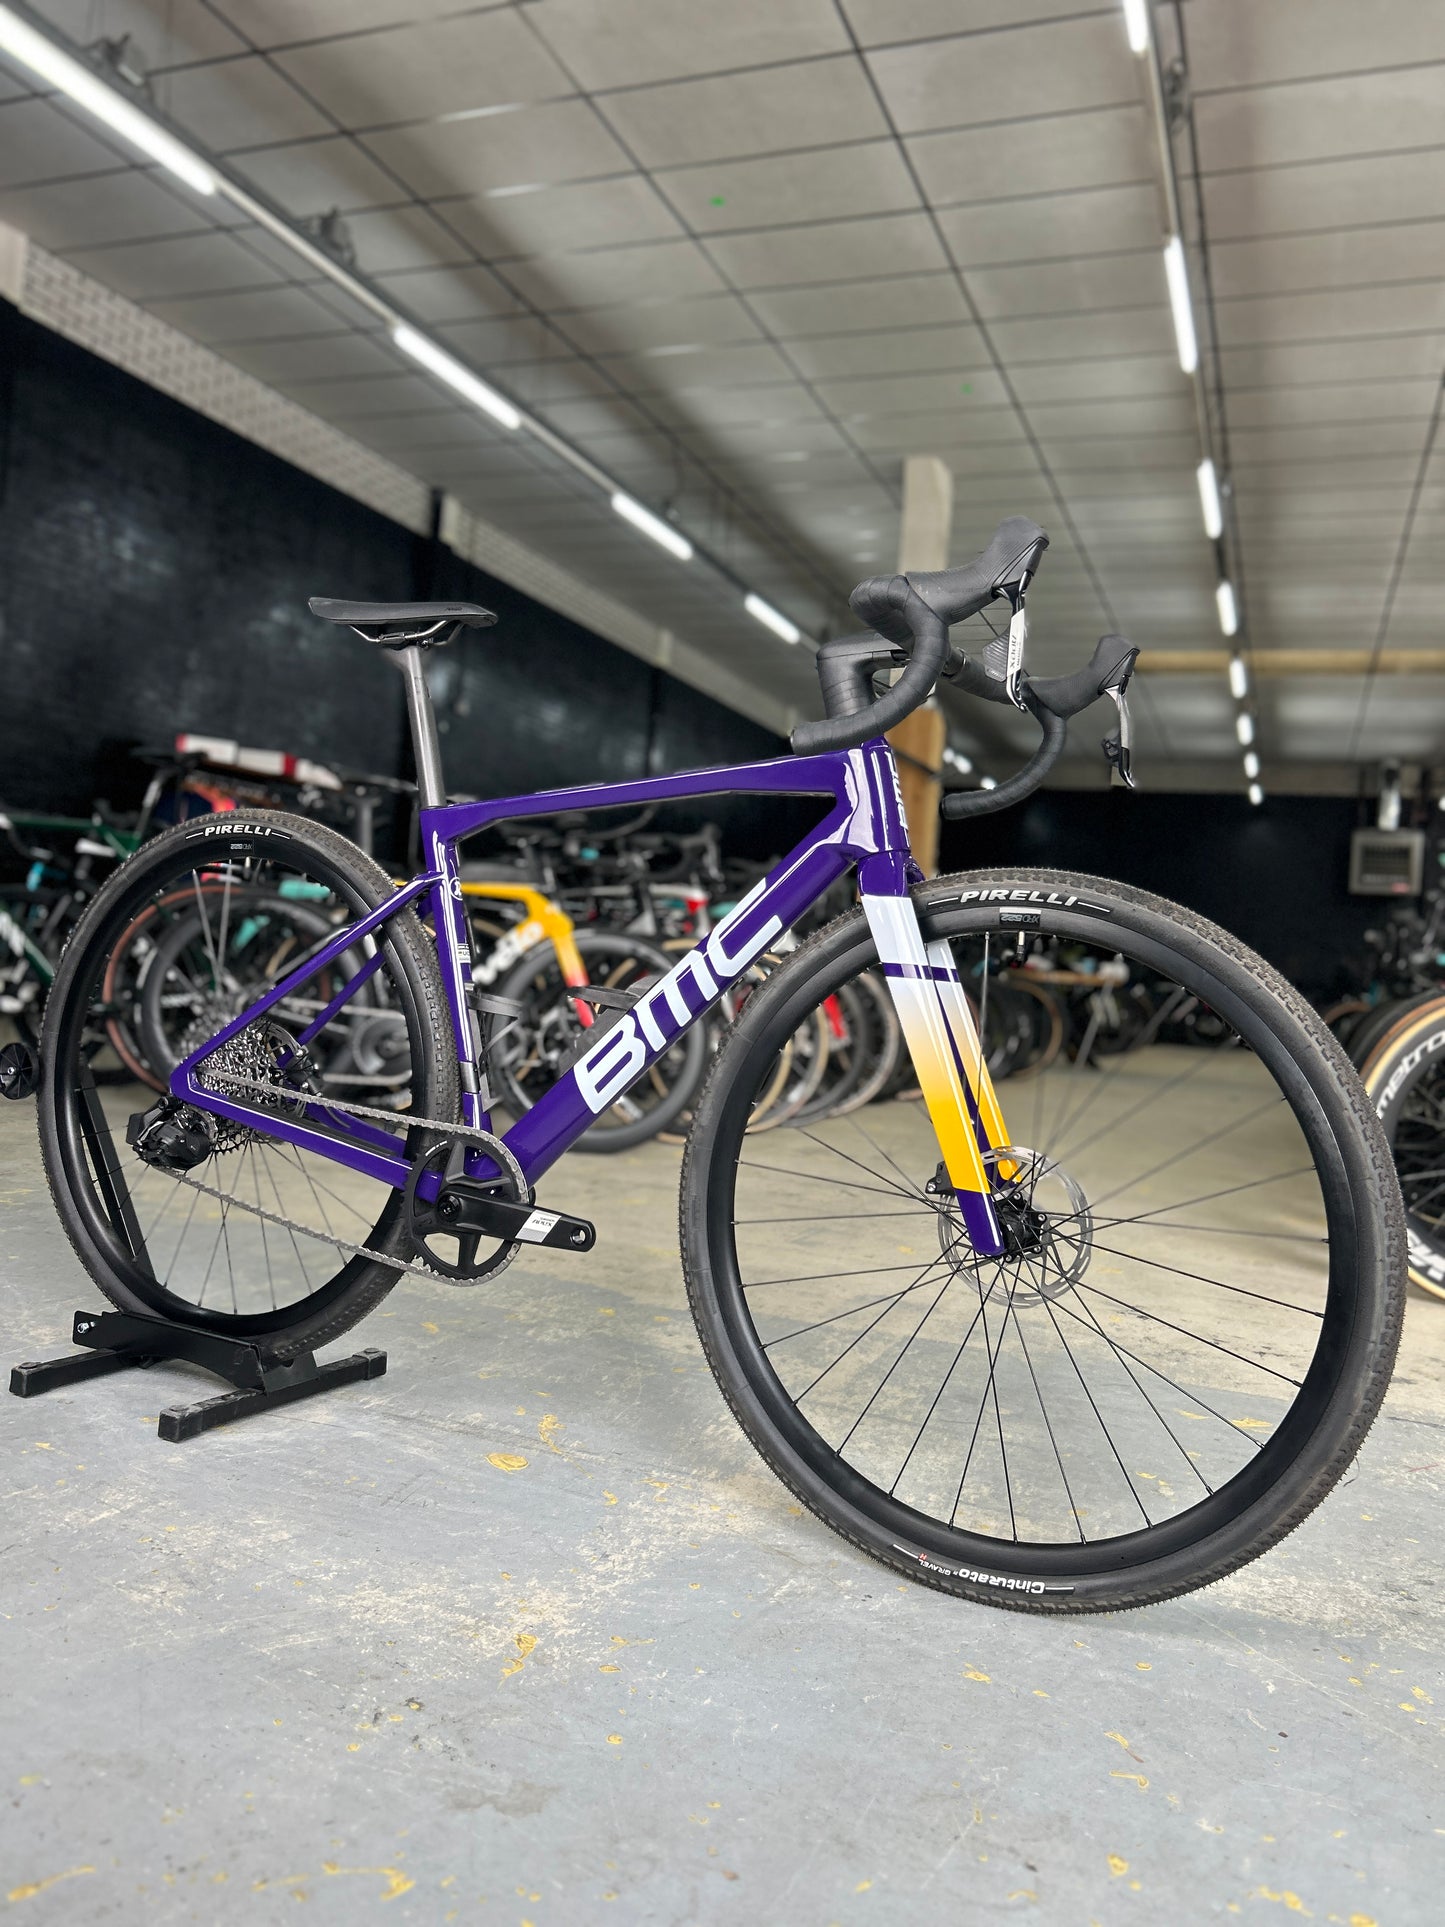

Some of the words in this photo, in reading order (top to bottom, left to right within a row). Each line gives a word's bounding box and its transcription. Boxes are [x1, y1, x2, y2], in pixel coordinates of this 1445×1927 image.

[204, 824, 272, 837] PIRELLI
[960, 889, 1078, 907] PIRELLI
[1000, 913, 1023, 922] 522
[573, 877, 783, 1114] BMC
[918, 1559, 951, 1576] GRAVEL
[959, 1568, 1046, 1594] Cinturato
